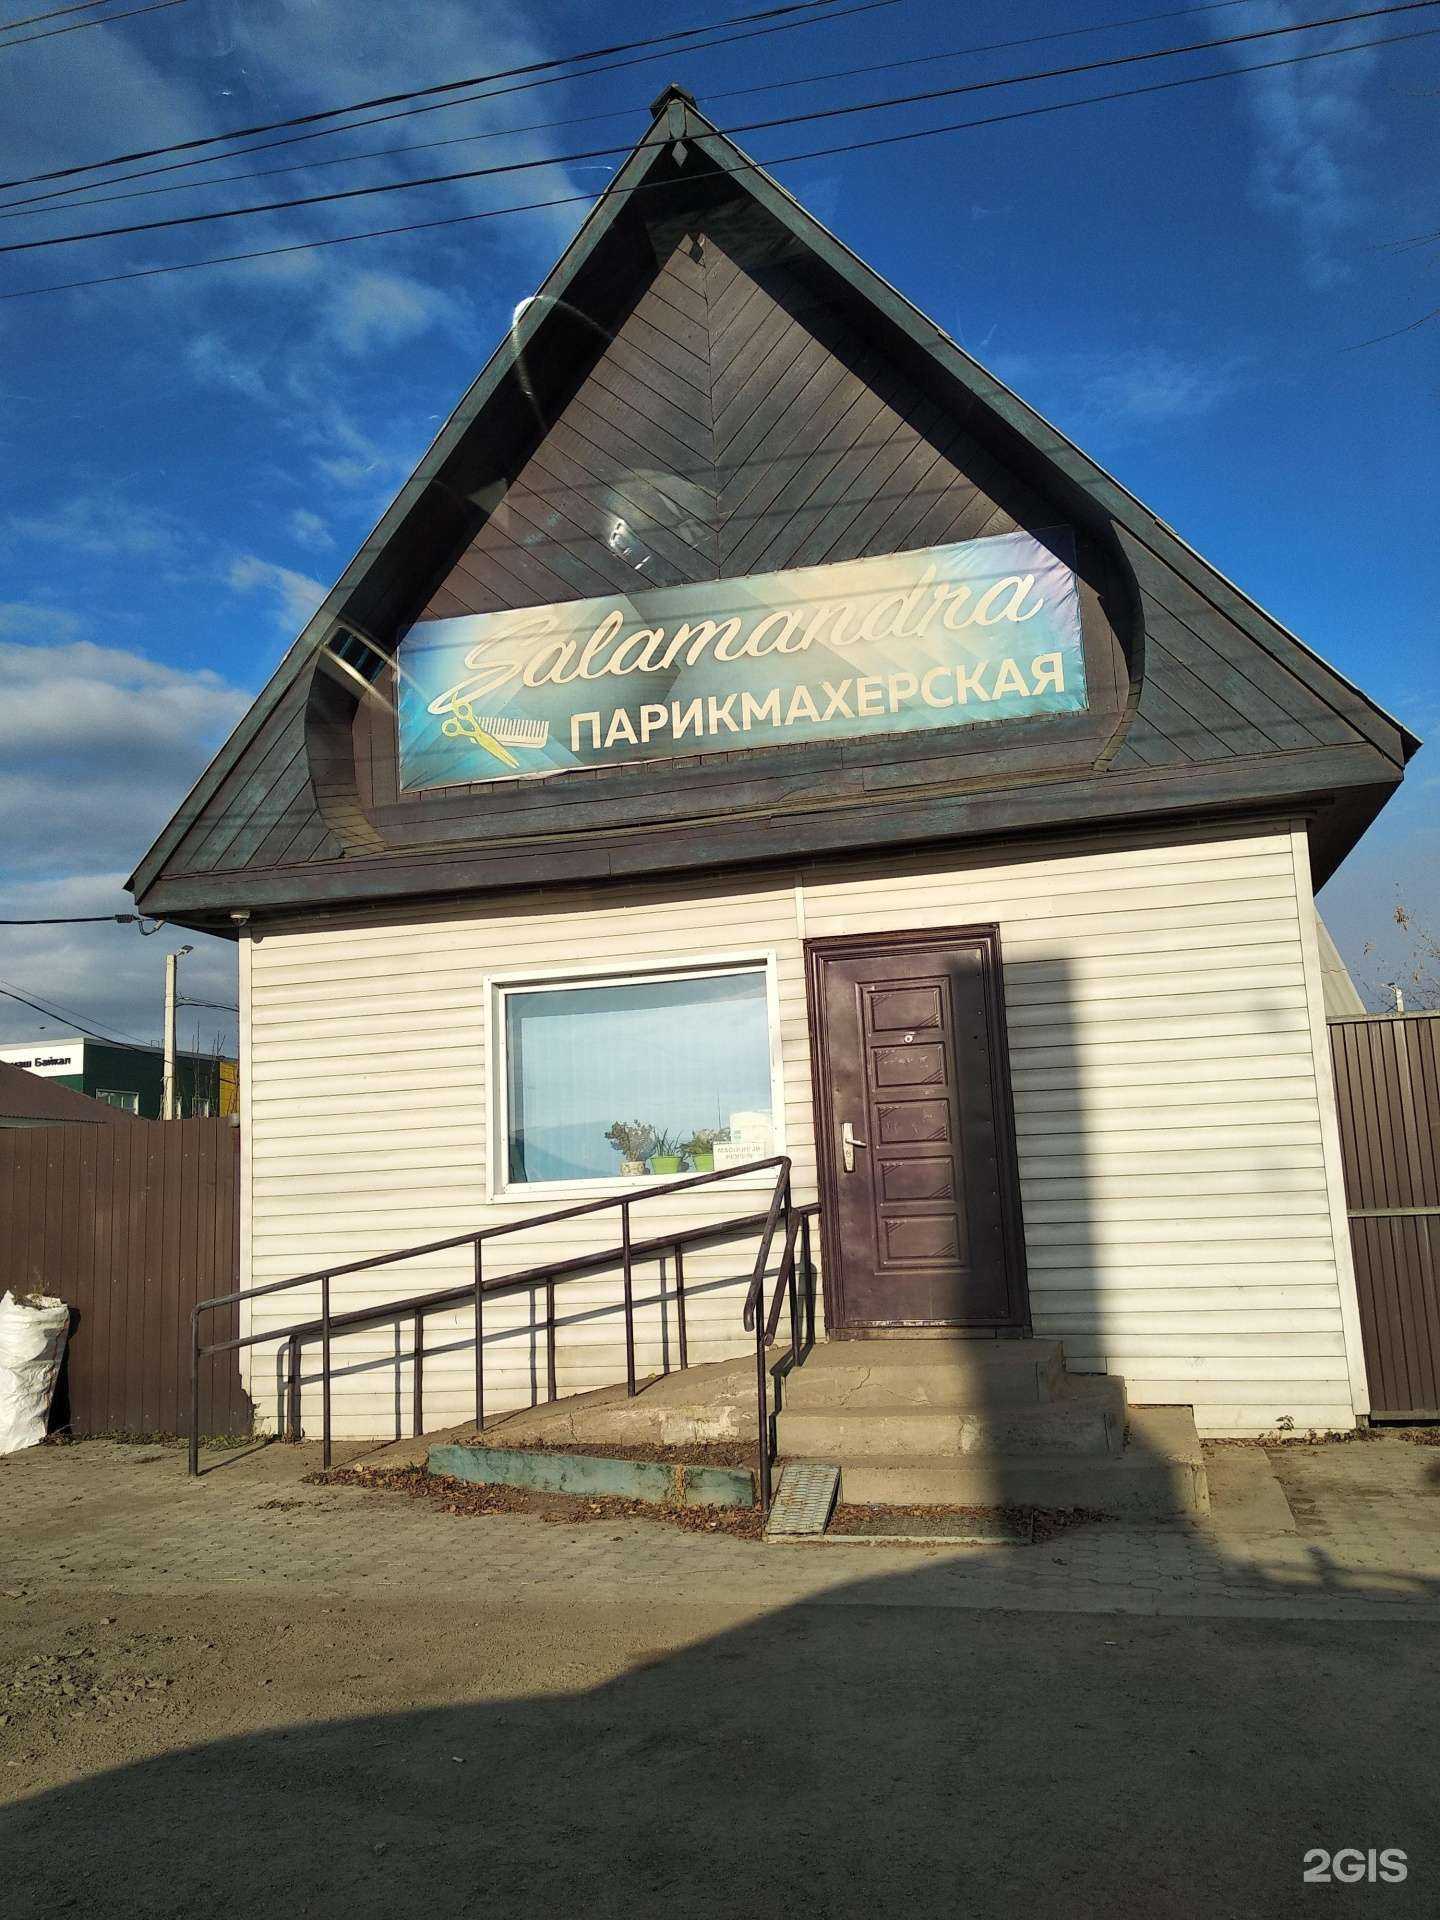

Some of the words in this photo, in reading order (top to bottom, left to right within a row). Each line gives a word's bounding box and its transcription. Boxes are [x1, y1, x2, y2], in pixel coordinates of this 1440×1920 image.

[427, 564, 1044, 714] Salamandra
[569, 651, 1066, 752] ПАРИКМАХЕРСКАЯ
[34, 1056, 71, 1067] Байкал
